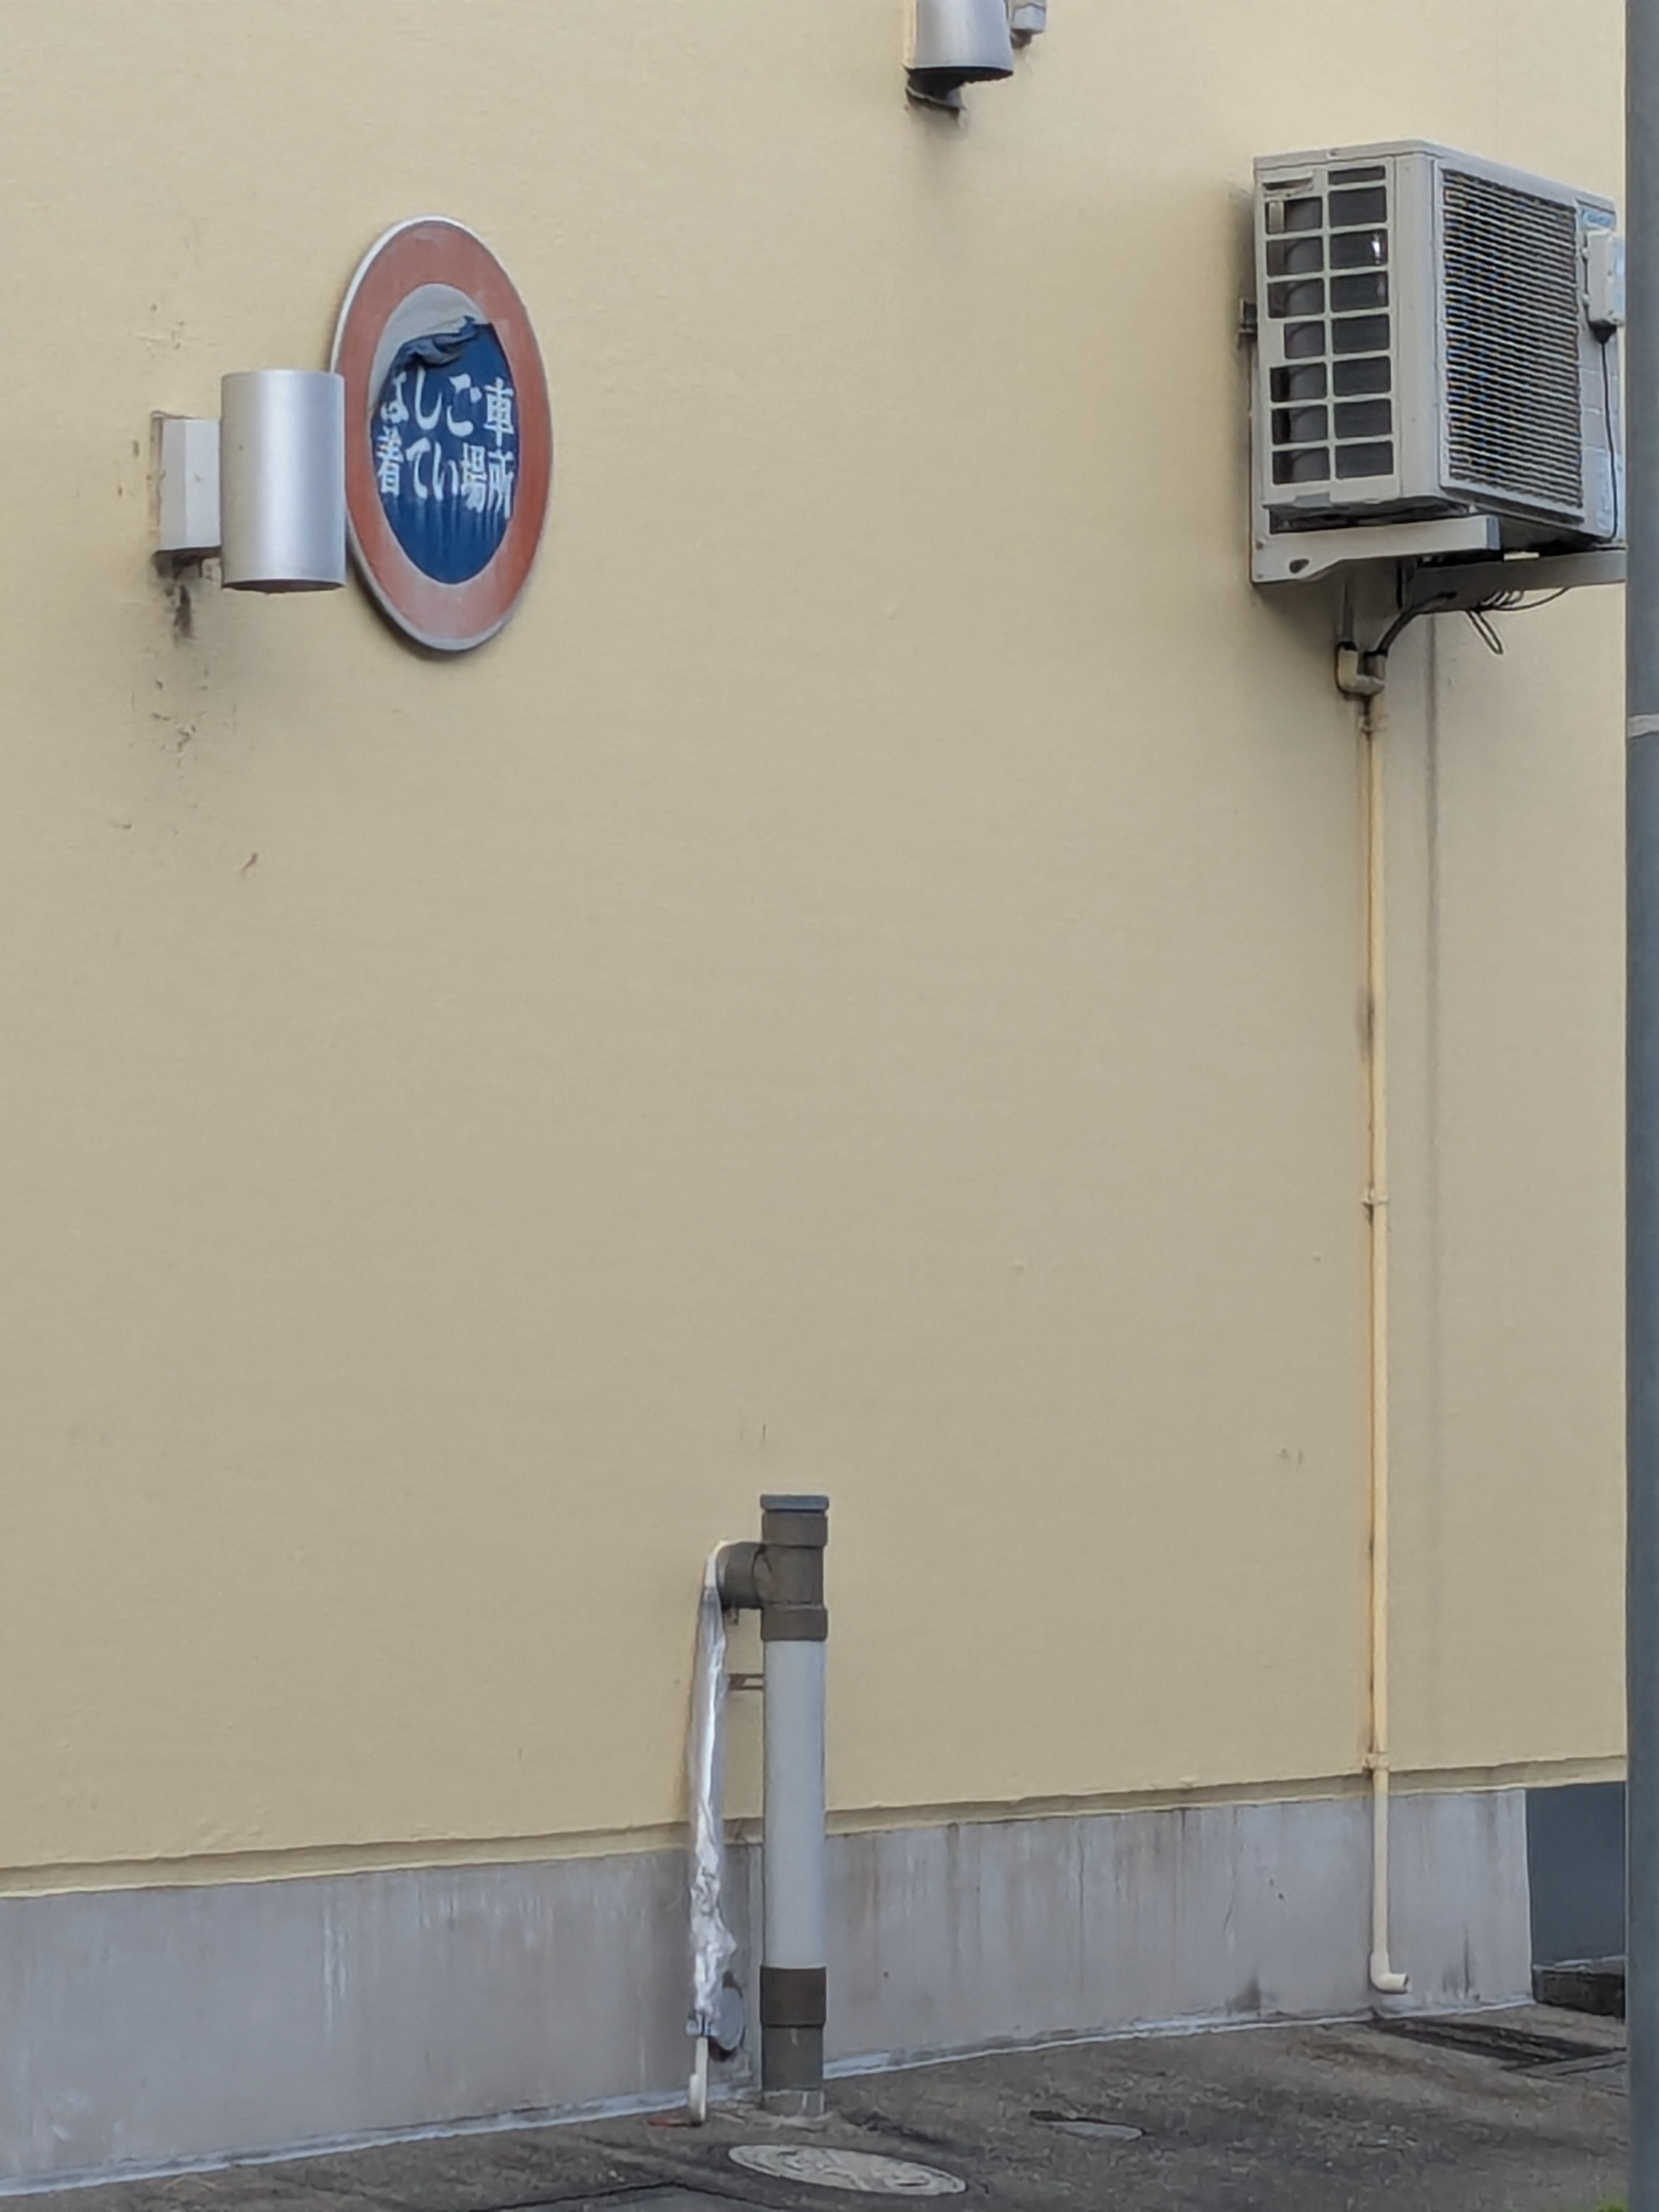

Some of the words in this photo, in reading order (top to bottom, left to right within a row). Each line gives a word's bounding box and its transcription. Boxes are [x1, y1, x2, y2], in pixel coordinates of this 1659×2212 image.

[376, 426, 515, 518] 着てい場所
